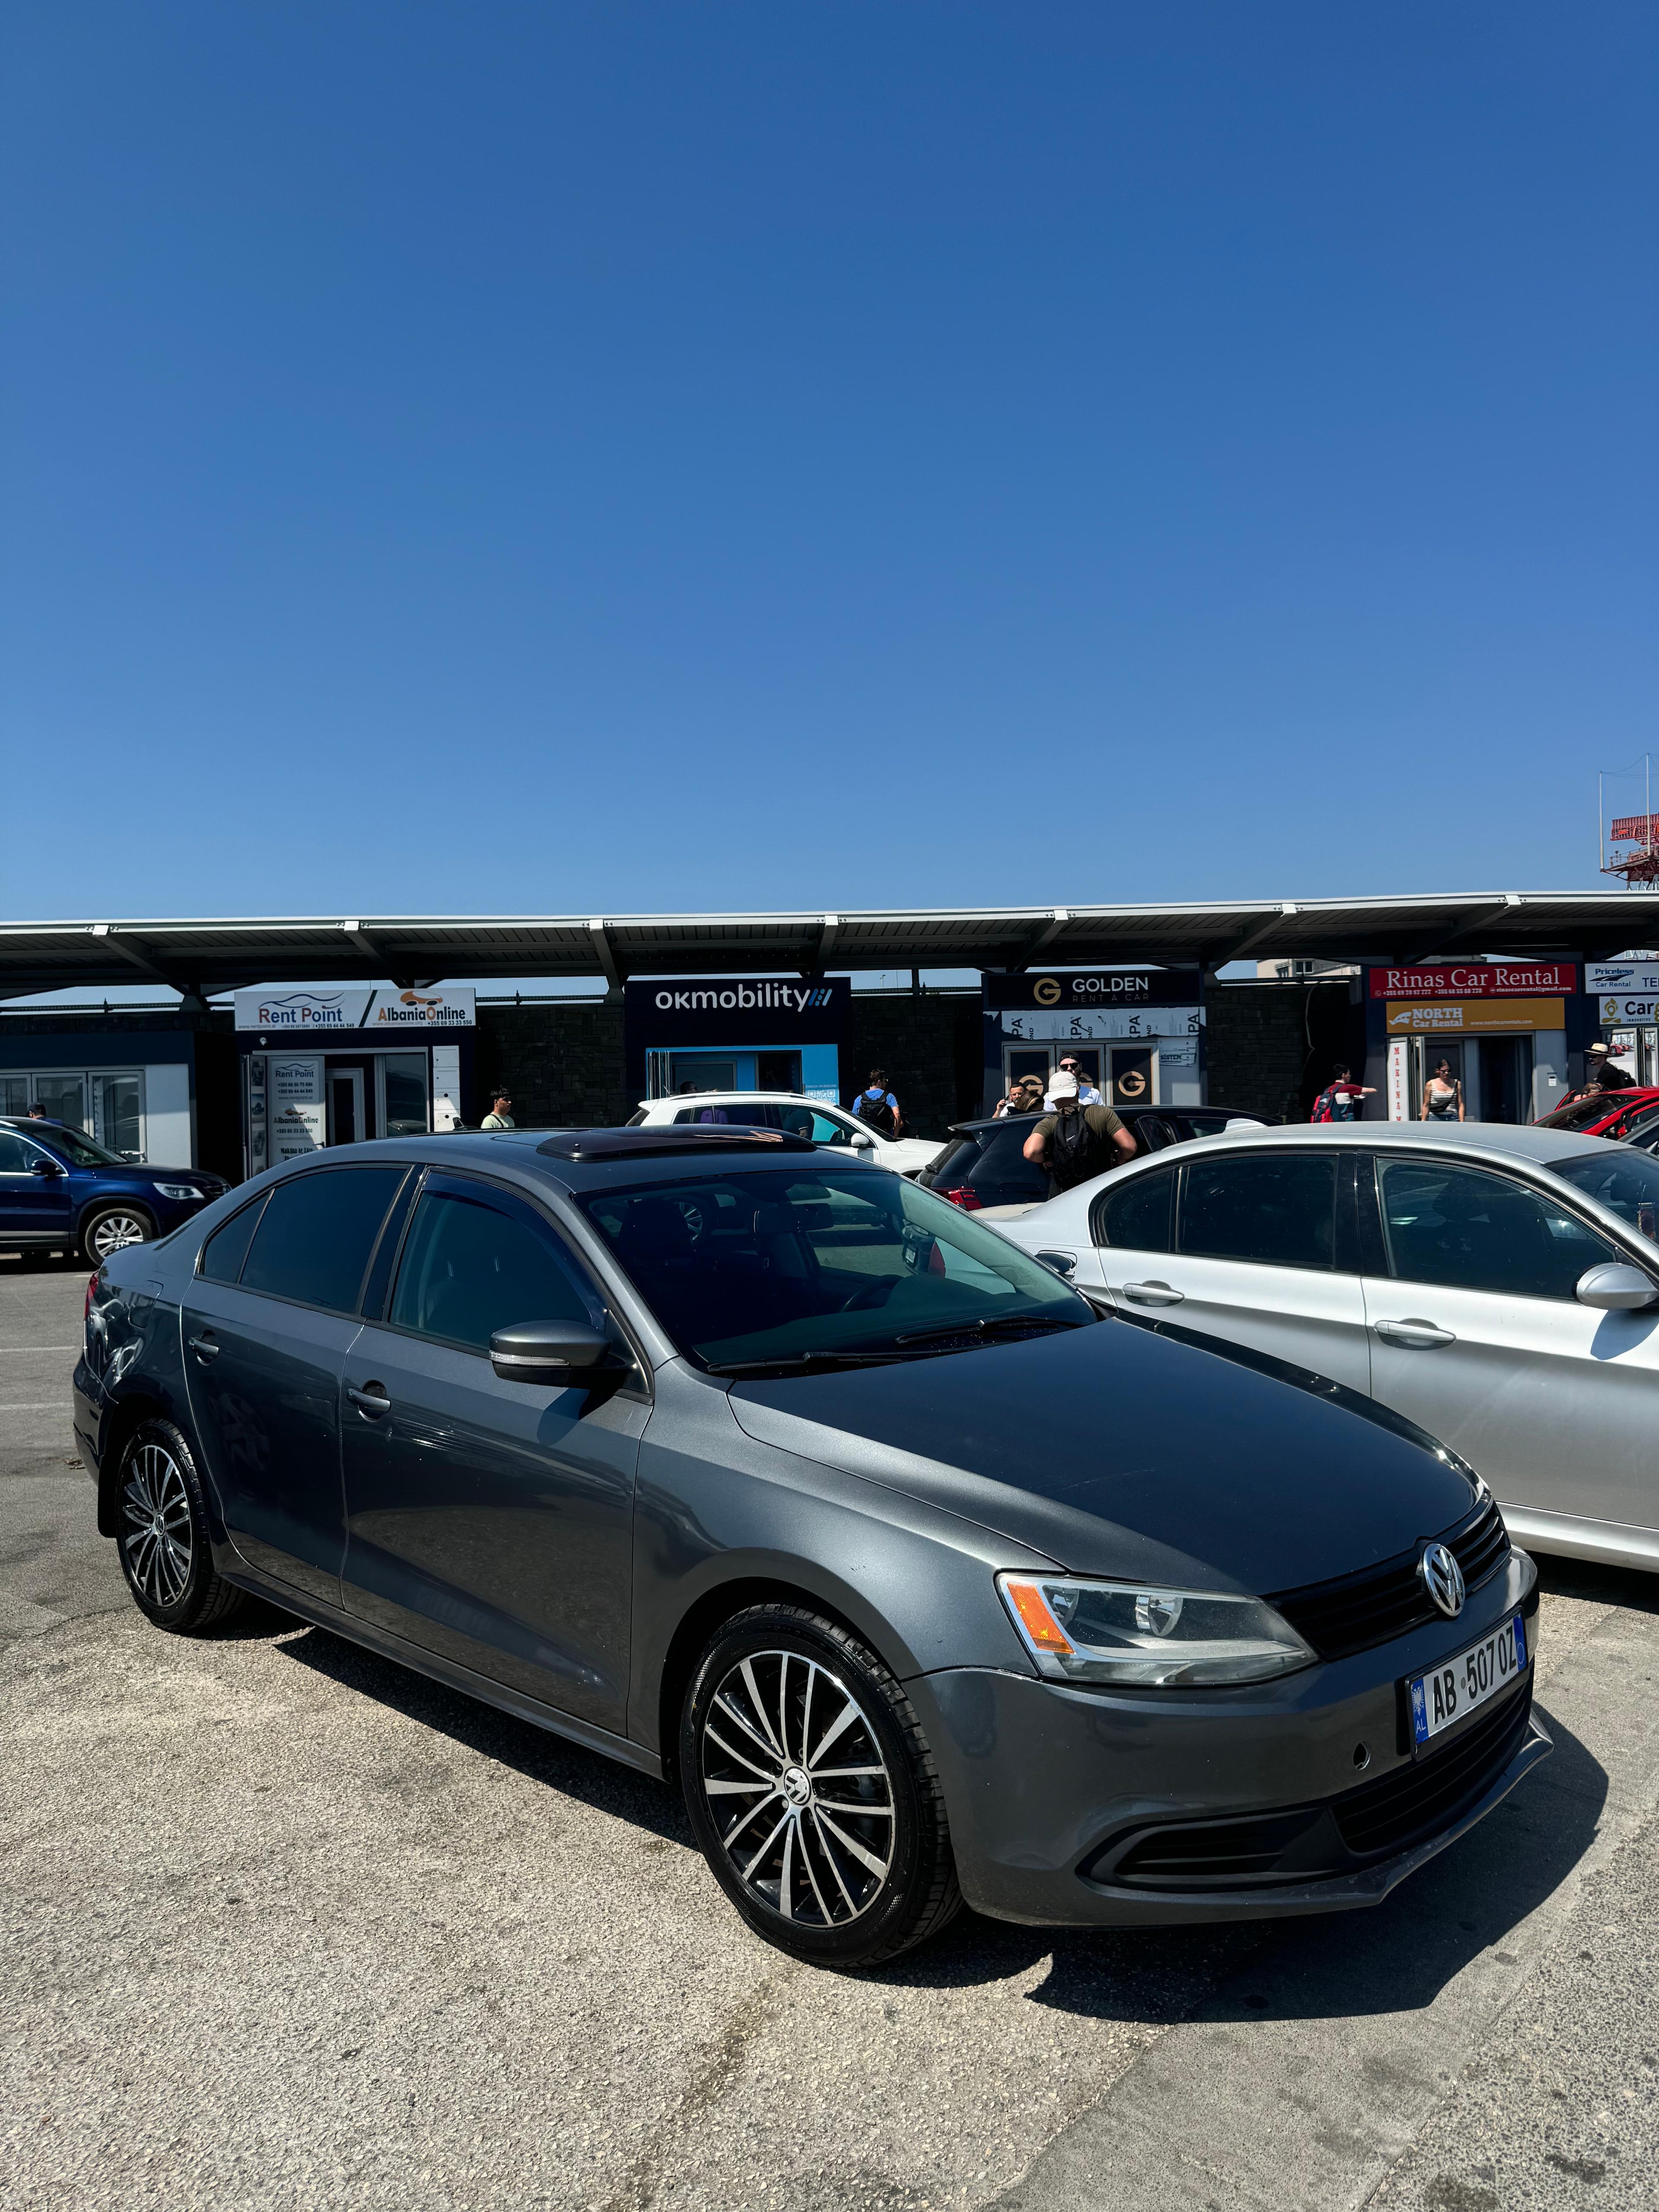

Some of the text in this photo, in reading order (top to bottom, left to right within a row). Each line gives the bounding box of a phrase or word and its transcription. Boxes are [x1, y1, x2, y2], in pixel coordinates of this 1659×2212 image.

[1072, 977, 1148, 993] GOLDEN
[1386, 967, 1560, 988] Rinas Car Rental
[655, 982, 810, 1012] okmobility
[259, 1007, 343, 1023] Rent Point
[378, 1006, 466, 1021] AlbaniaOnline
[1412, 1007, 1463, 1019] NORTH
[1071, 1017, 1082, 1039] PA
[1129, 1015, 1141, 1038] PA
[1412, 1018, 1463, 1028] Car Rental
[1433, 1669, 1456, 1725] AB
[1467, 1639, 1494, 1700] 507
[1416, 1718, 1426, 1734] AL
